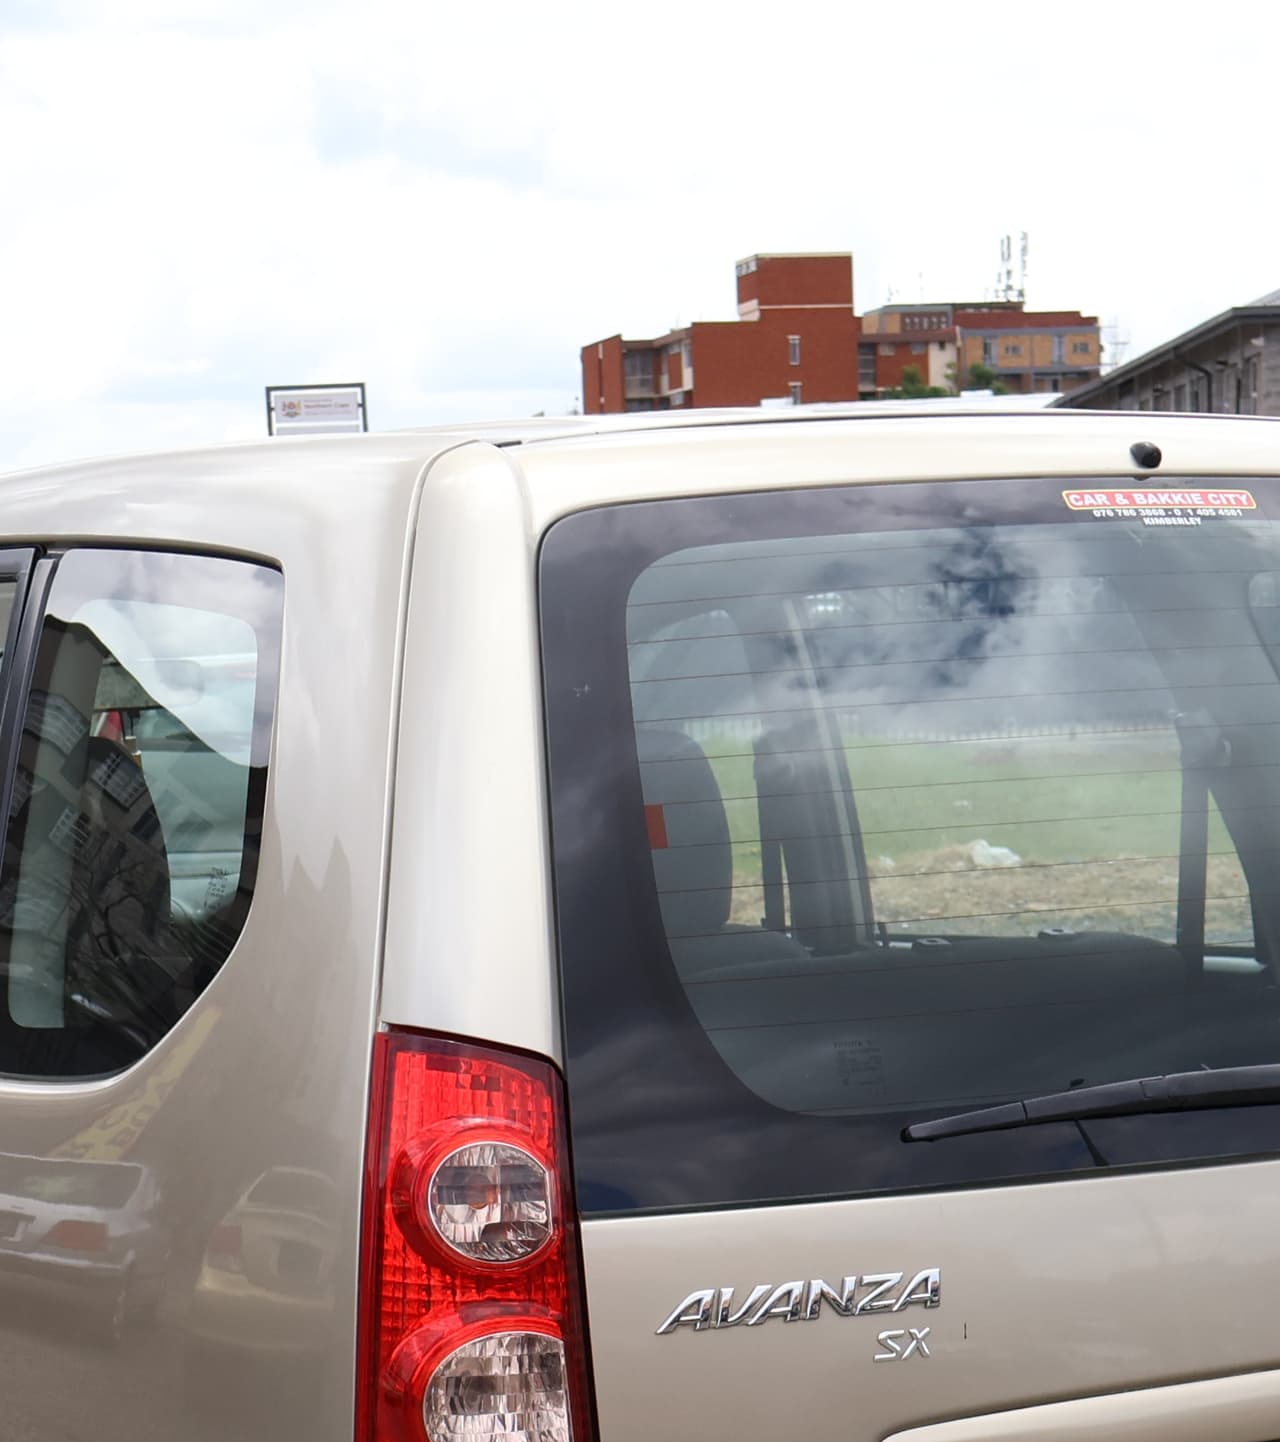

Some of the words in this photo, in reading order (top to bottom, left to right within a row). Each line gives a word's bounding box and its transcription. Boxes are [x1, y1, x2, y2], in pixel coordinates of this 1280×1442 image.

[1068, 493, 1110, 506] CAR
[1114, 493, 1130, 505] &
[1132, 493, 1205, 505] BAKKIE
[1207, 493, 1249, 505] CITY
[1143, 517, 1201, 526] KIMBERLEY
[654, 1267, 941, 1335] AVANZA
[873, 1326, 931, 1362] SX
